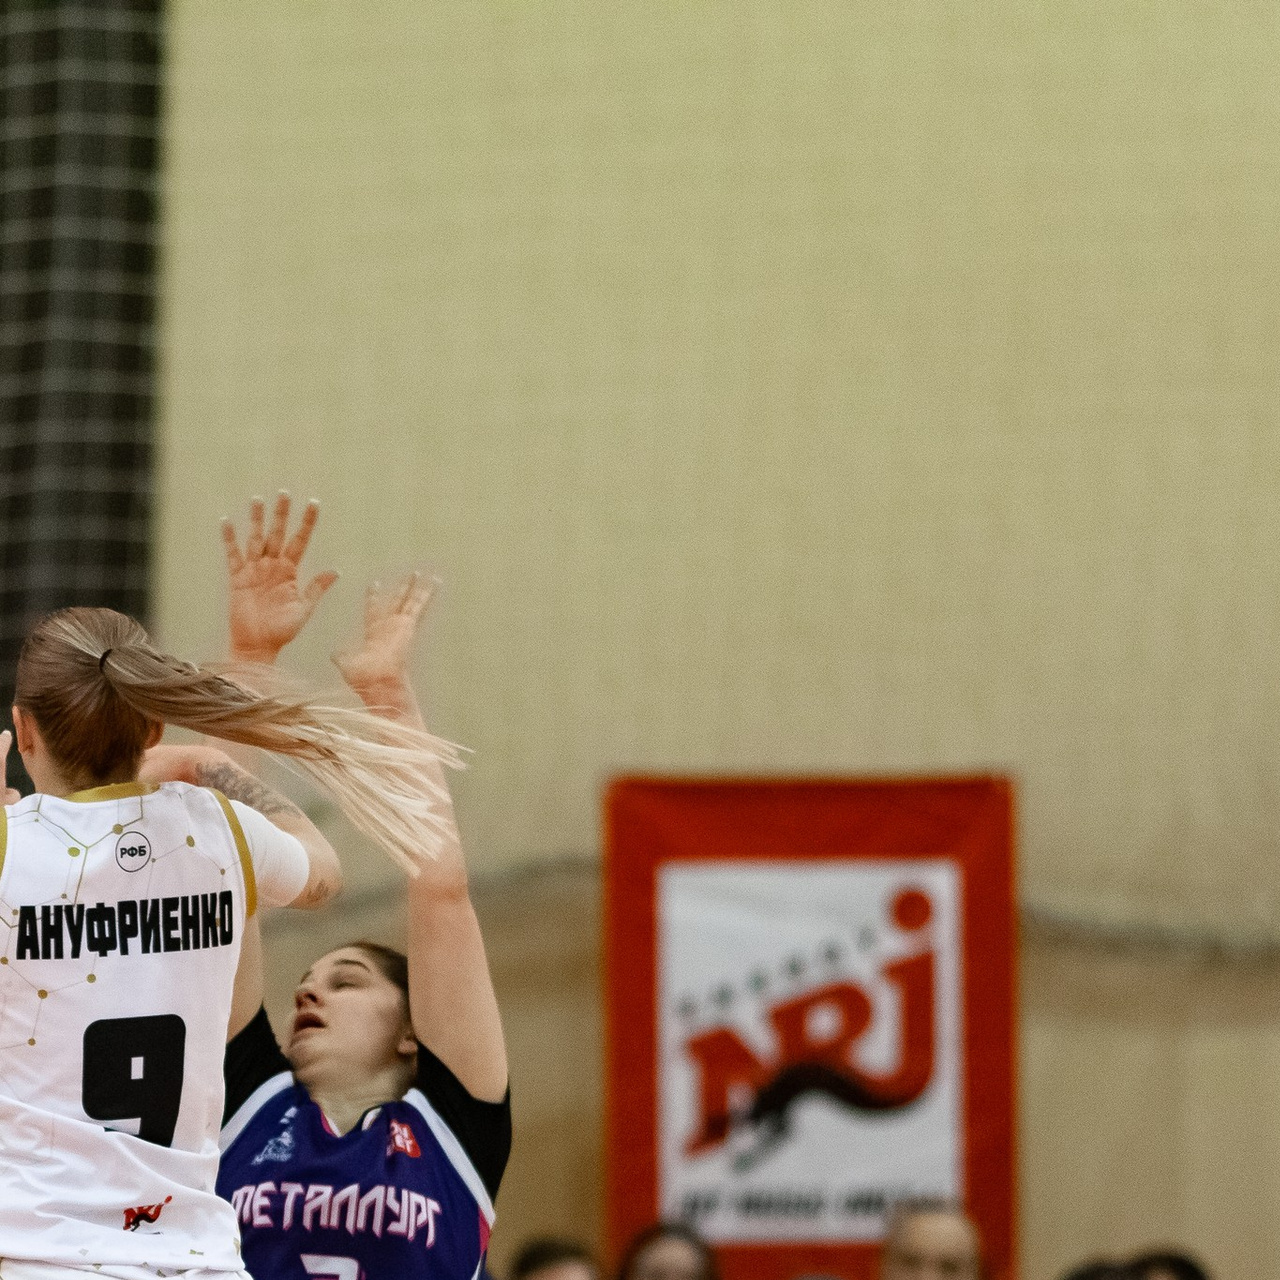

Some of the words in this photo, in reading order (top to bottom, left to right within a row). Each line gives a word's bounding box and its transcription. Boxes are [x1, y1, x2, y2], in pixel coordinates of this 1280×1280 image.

[120, 845, 147, 858] РФБ
[16, 890, 233, 960] АНУФРИЕНКО
[82, 1014, 187, 1148] 9
[232, 1181, 442, 1248] МЕТАЛЛУРГ
